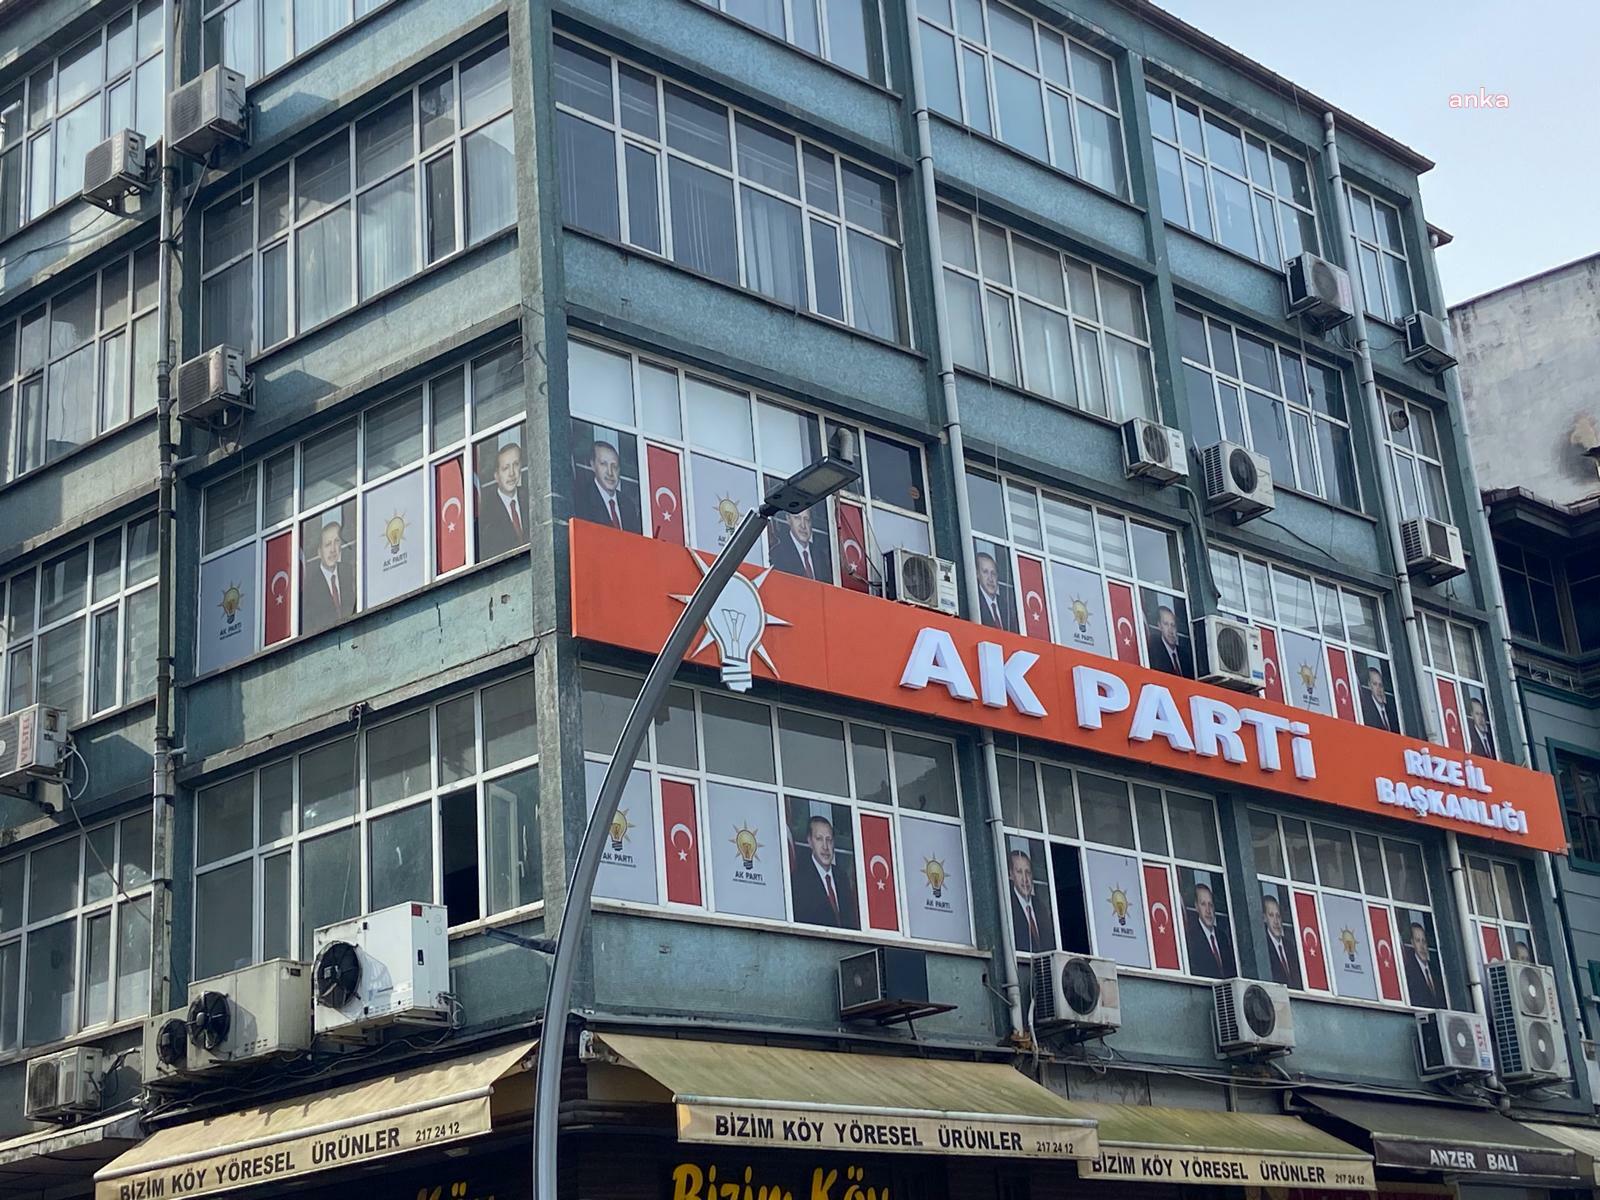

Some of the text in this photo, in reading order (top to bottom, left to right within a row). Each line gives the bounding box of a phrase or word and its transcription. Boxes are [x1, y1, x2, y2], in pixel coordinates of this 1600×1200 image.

[899, 627, 1049, 718] AK
[603, 852, 612, 860] AK
[735, 870, 744, 879] AK
[715, 1112, 1074, 1154] BİZİM KÖY YÖRESEL ÜRÜNLER 217 24 12
[119, 1122, 460, 1200] BİZİM KÖY YÖRESEL ÜRÜNLER 217 24 12
[1142, 1154, 1173, 1177] KÖY
[1180, 1156, 1249, 1180] YÖRESEL
[1260, 1160, 1327, 1184] ÜRÜNLER
[1429, 1149, 1519, 1172] ANZER BALI
